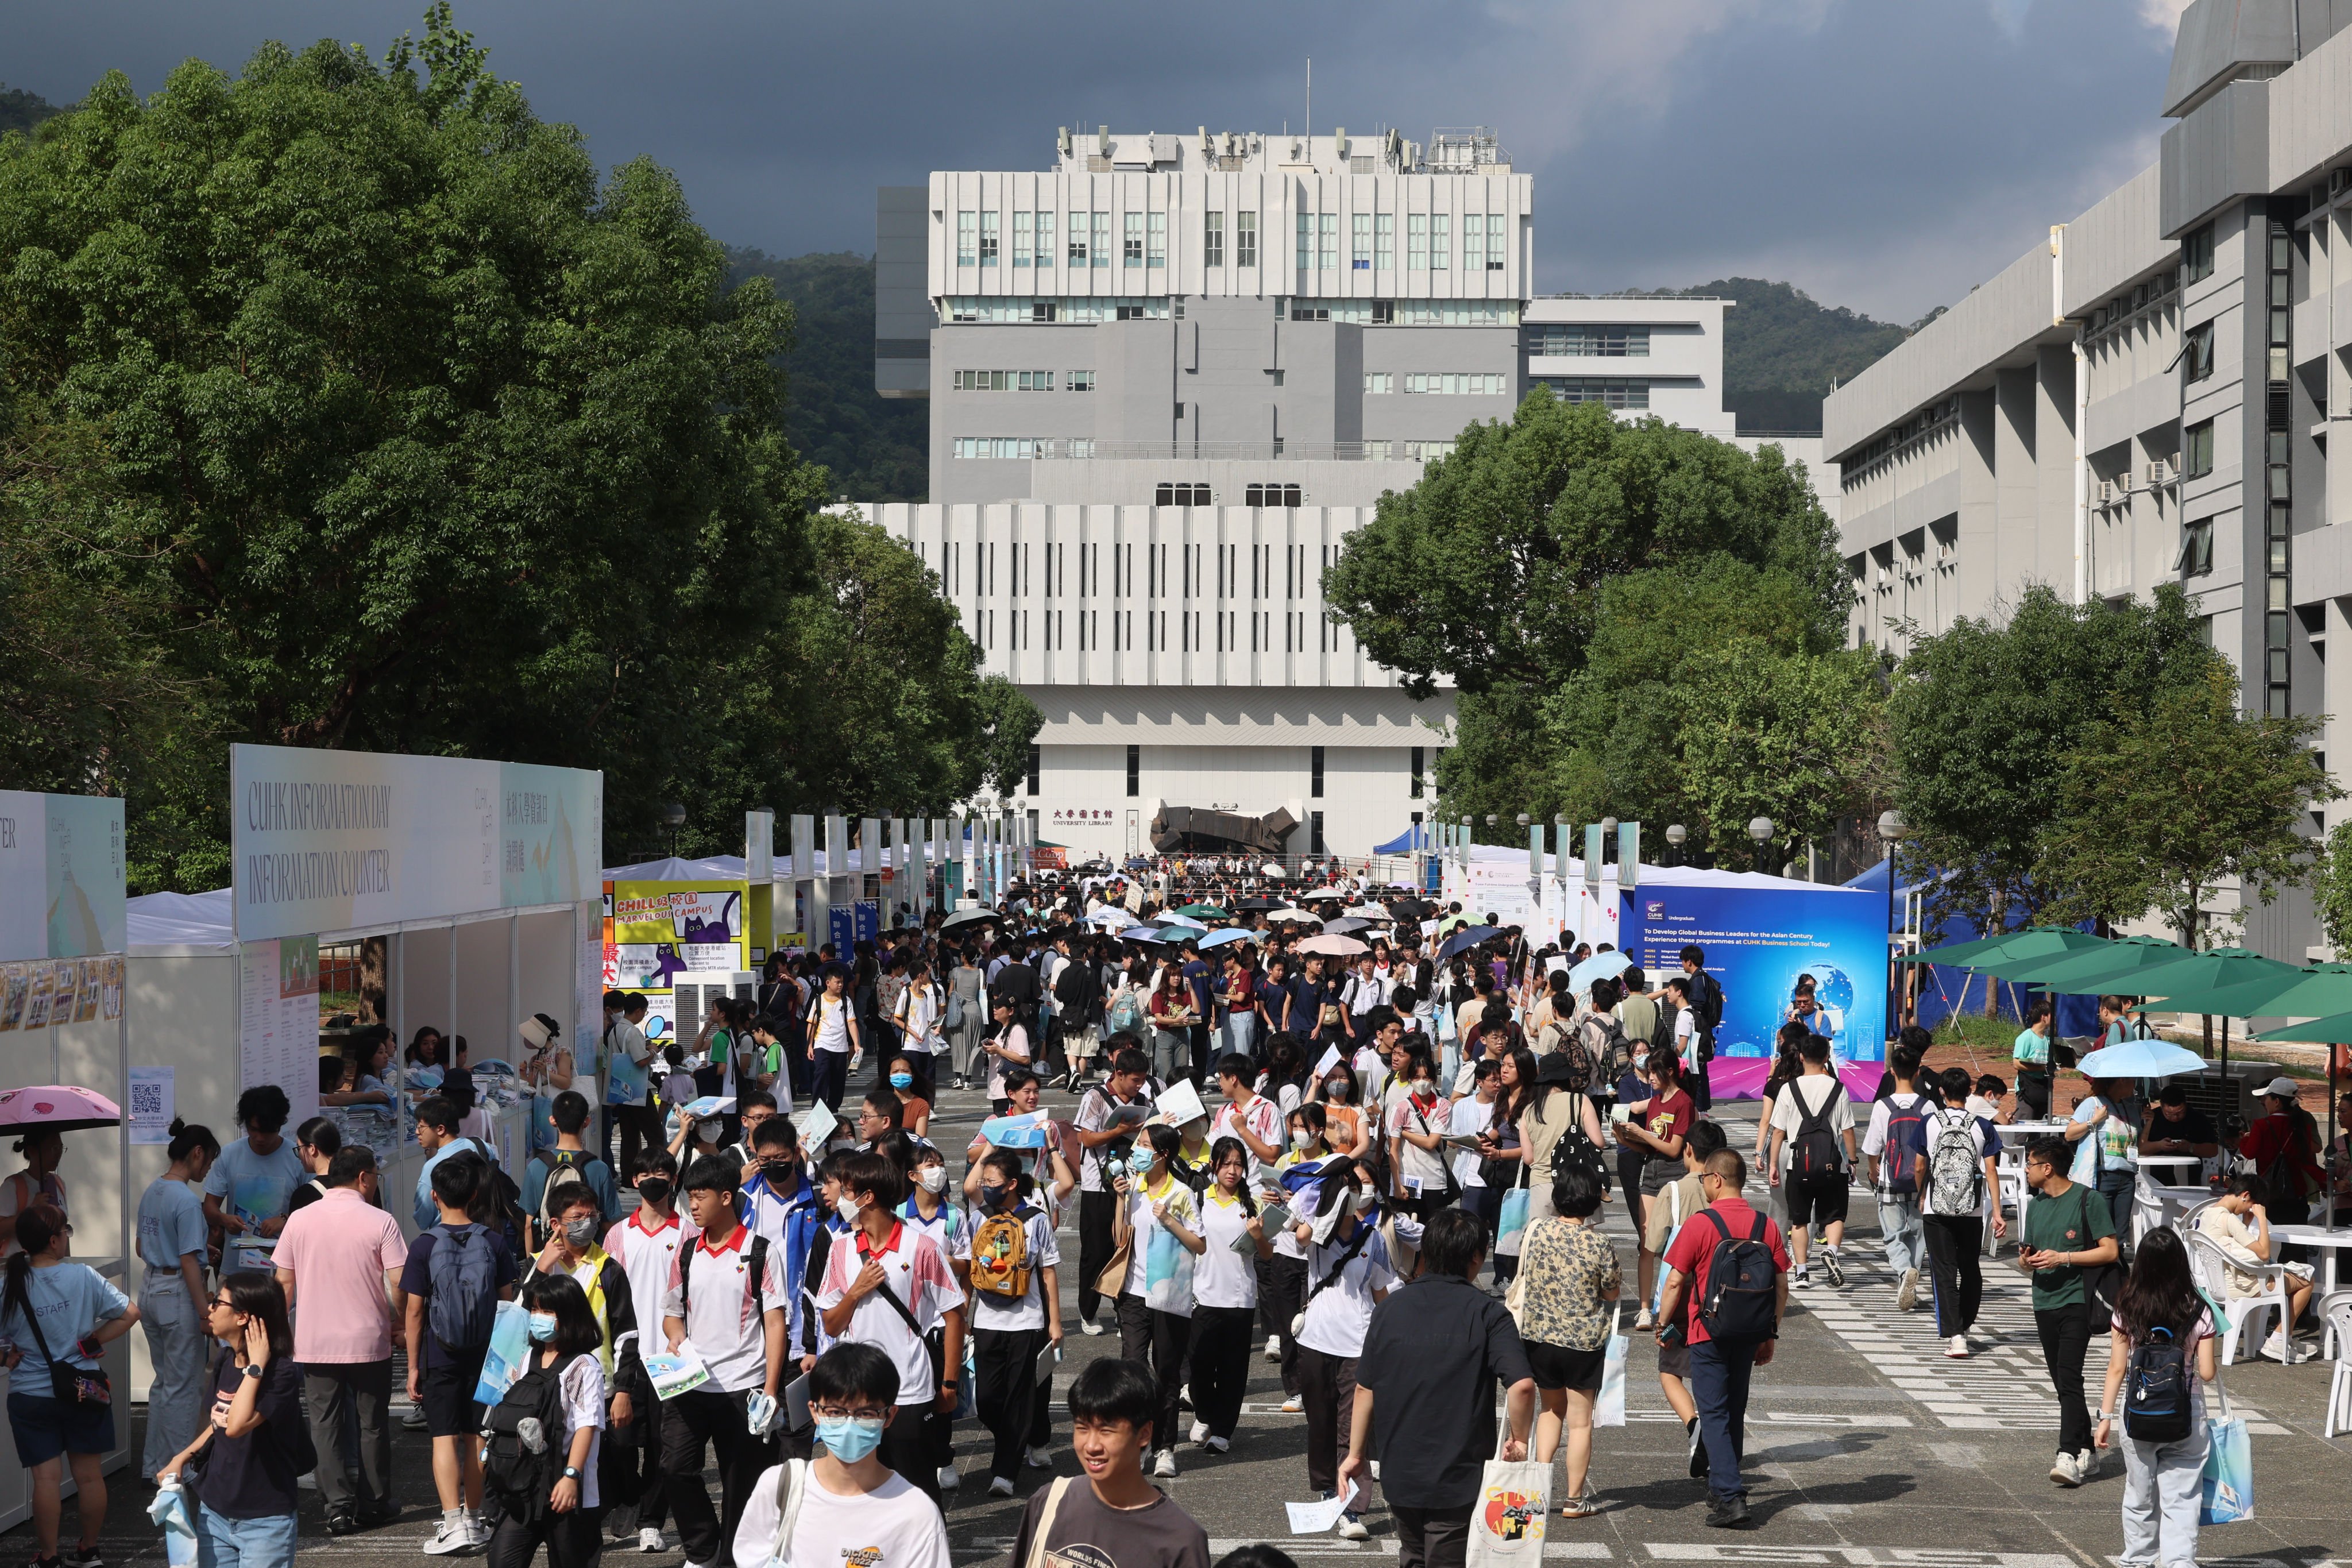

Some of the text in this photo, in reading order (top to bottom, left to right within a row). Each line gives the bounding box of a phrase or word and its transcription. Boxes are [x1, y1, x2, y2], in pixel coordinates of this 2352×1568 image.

[249, 781, 391, 831] CUHK INFORMATION DAY
[505, 790, 547, 826] 本科大學資訊日
[1053, 809, 1113, 819] 大學圖書館
[249, 849, 390, 905] INFORMATION COUNTER
[616, 905, 713, 925] MARVELOUS CAMPUS
[833, 921, 843, 959] 聯合書院
[603, 943, 619, 983] 最大
[1570, 1125, 1577, 1133] 8
[36, 1300, 70, 1316] STAFF
[1604, 1414, 1620, 1423] DAY
[1485, 1486, 1541, 1506] CUHK
[1488, 1517, 1544, 1540] ARTS
[841, 1548, 883, 1561] DICKIES
[849, 1557, 871, 1567] 1922
[1067, 1548, 1114, 1568] WORLDS FINES
